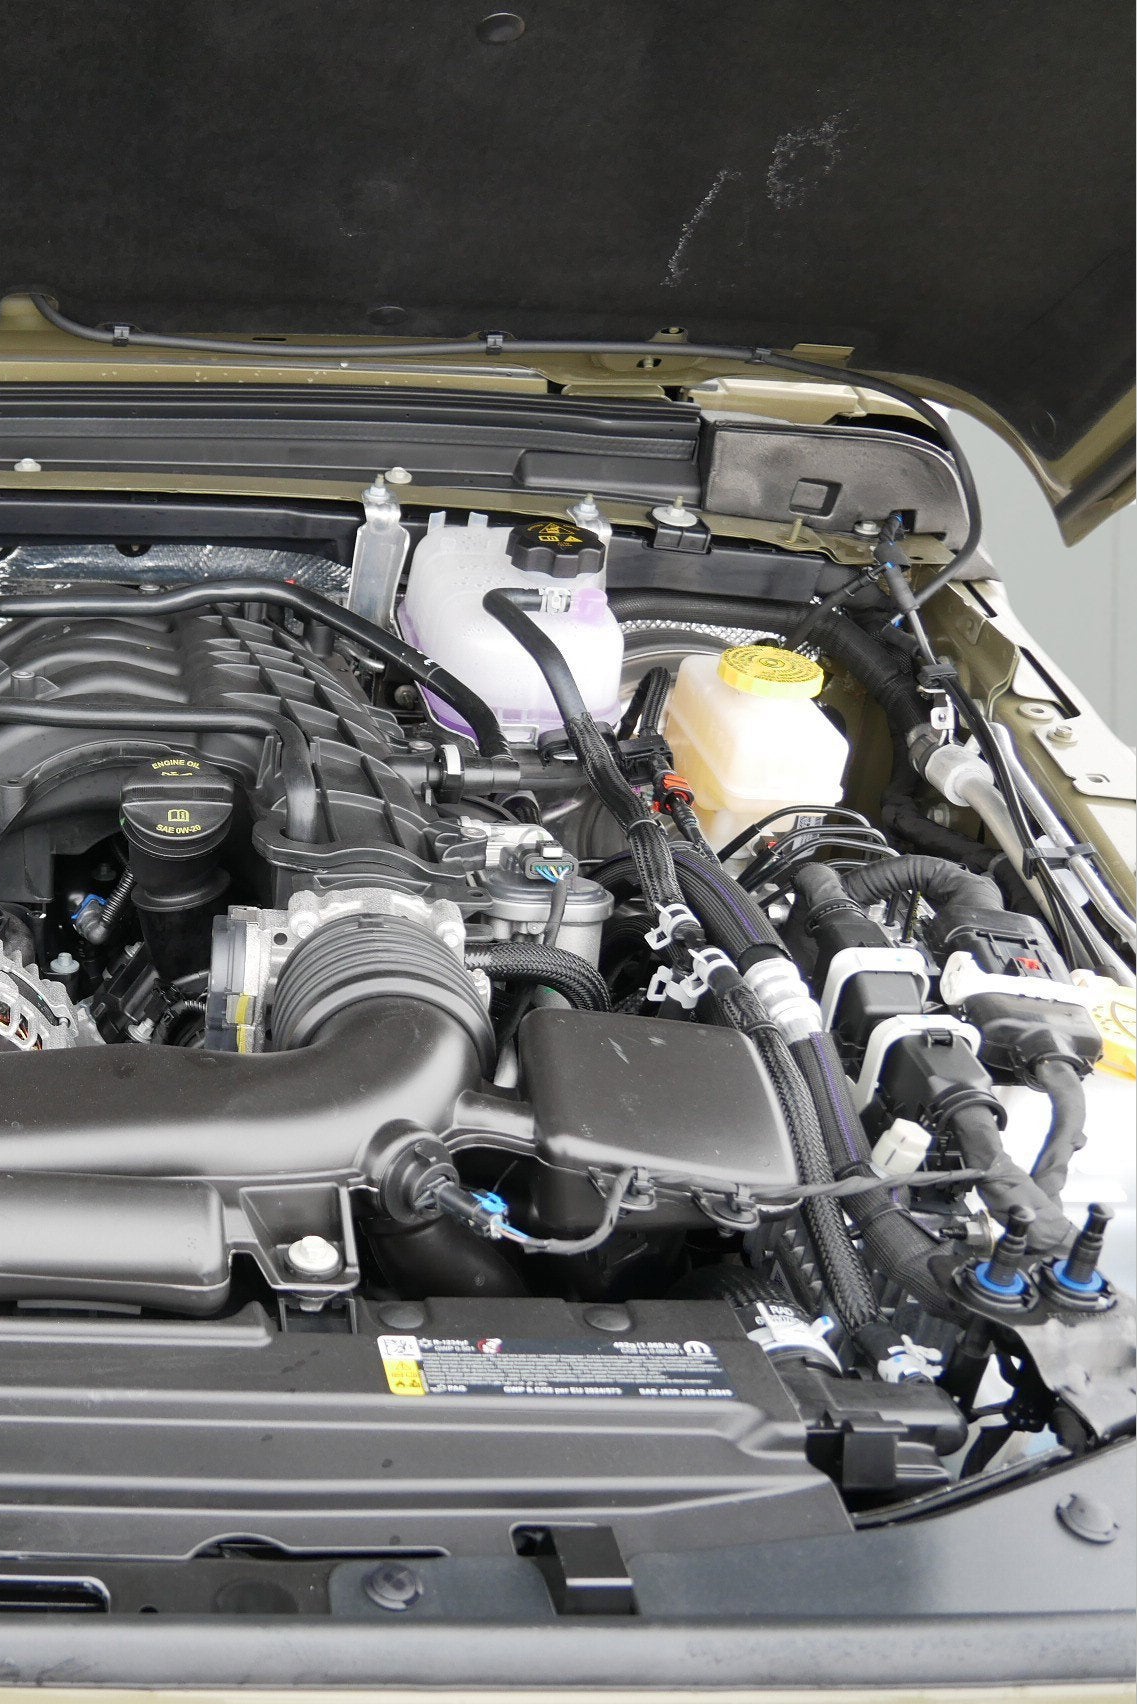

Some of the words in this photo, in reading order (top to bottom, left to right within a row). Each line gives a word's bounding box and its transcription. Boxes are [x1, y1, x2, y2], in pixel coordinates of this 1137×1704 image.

[151, 759, 185, 769] ENGINE
[187, 760, 200, 769] OIL
[155, 824, 175, 834] SAE
[176, 824, 201, 834] 0W-20
[768, 1304, 795, 1317] RAD
